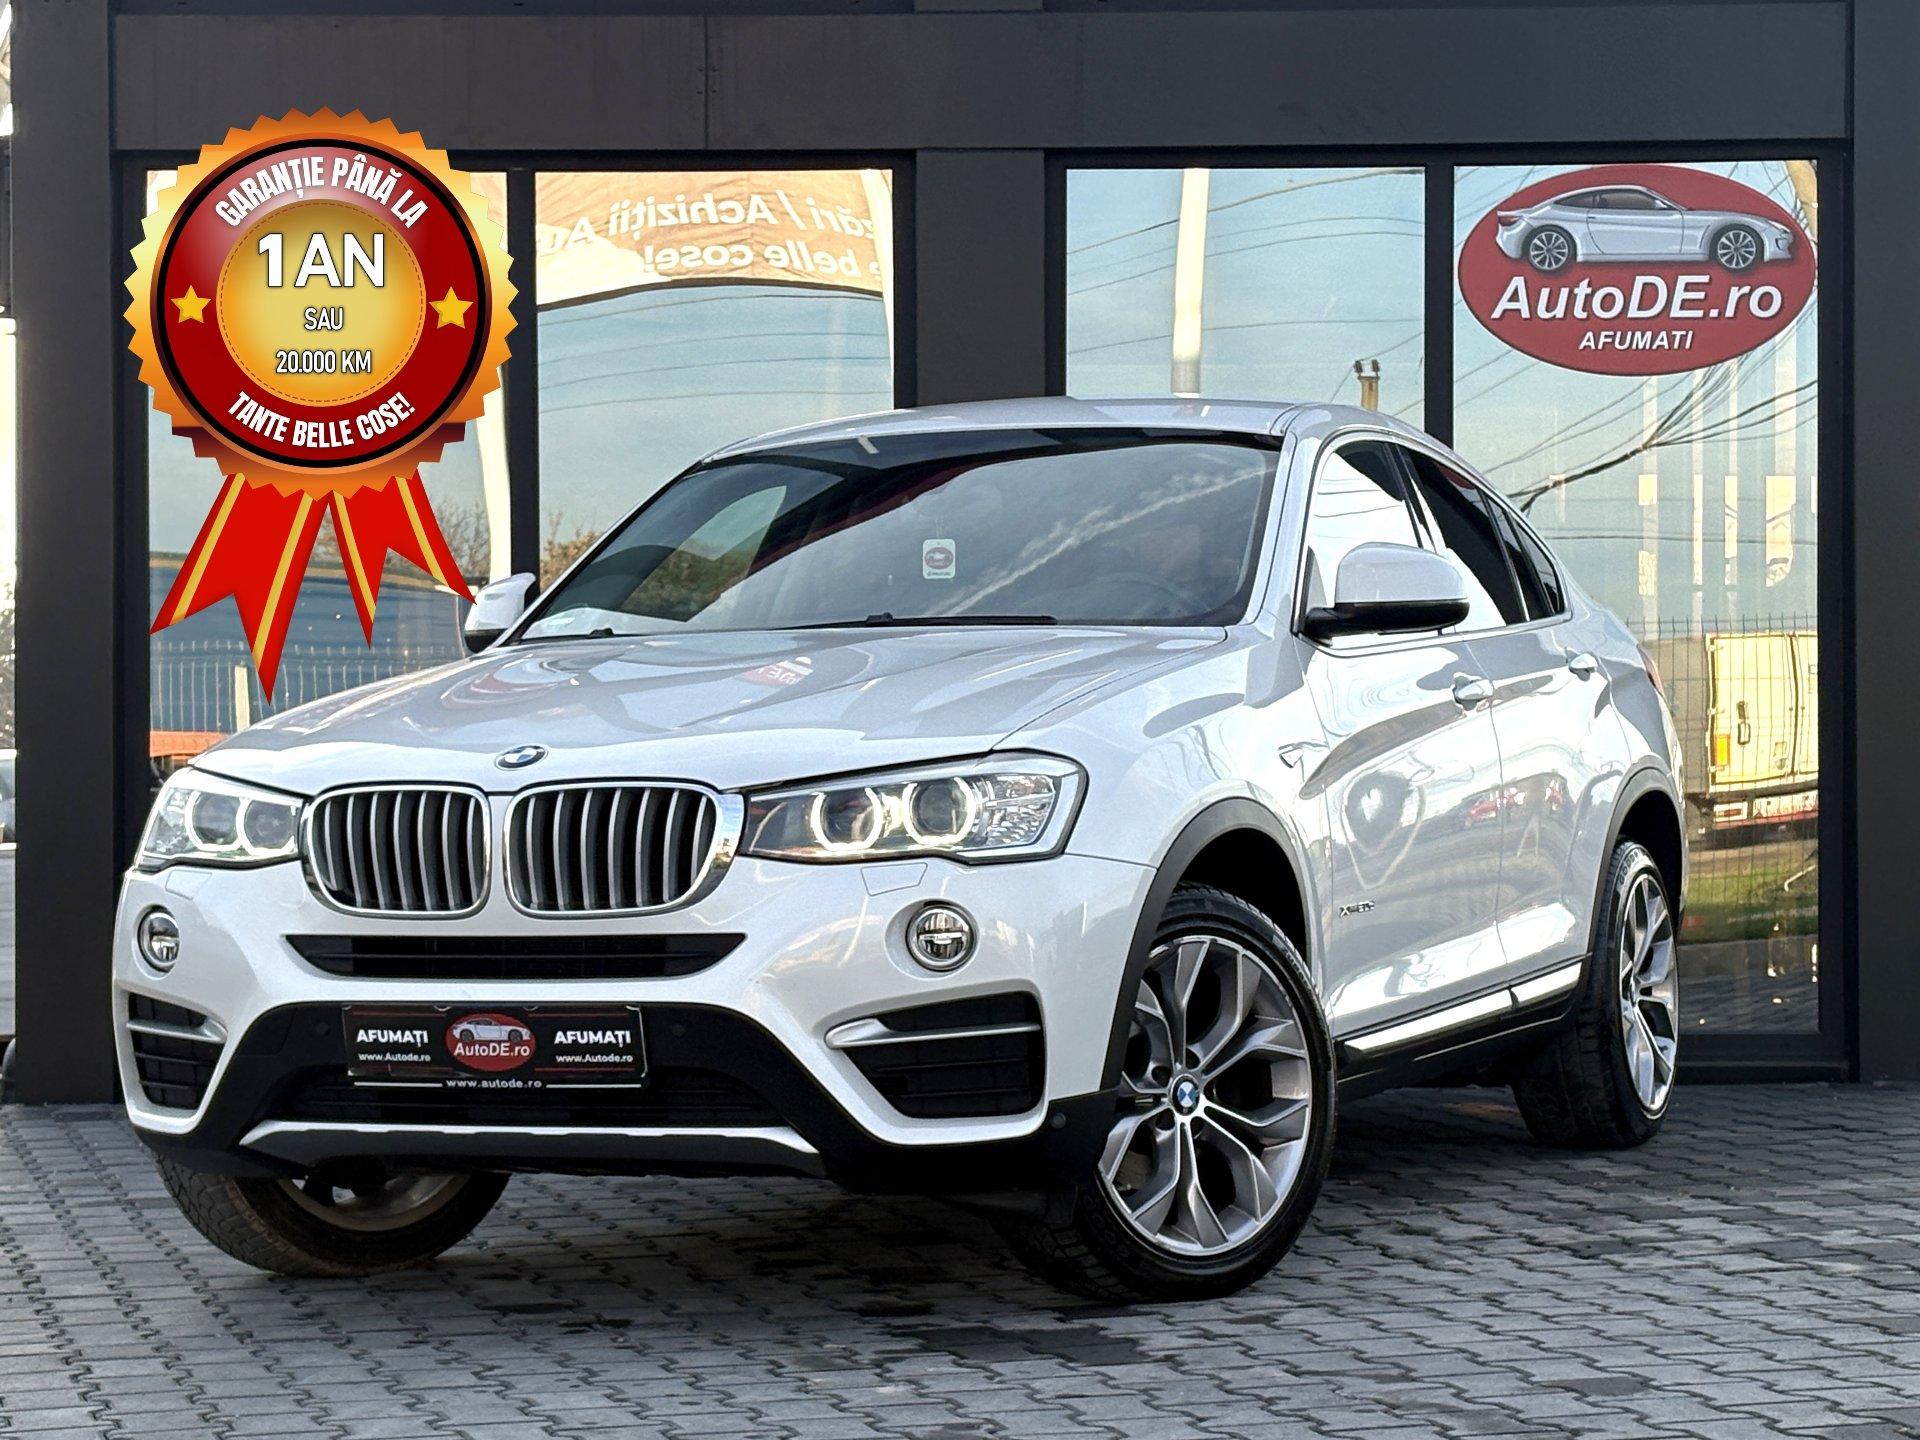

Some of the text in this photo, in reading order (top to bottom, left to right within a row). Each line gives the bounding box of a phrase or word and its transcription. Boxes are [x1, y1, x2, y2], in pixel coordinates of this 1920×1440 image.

[1490, 274, 1783, 320] AutoDE.ro
[1578, 331, 1694, 351] AFUMATI
[453, 1042, 530, 1056] AutoDE.ro
[358, 1052, 431, 1062] www.Autode.ro
[556, 1053, 633, 1063] www.Autode.ro
[445, 1079, 542, 1088] www.autode.ro
